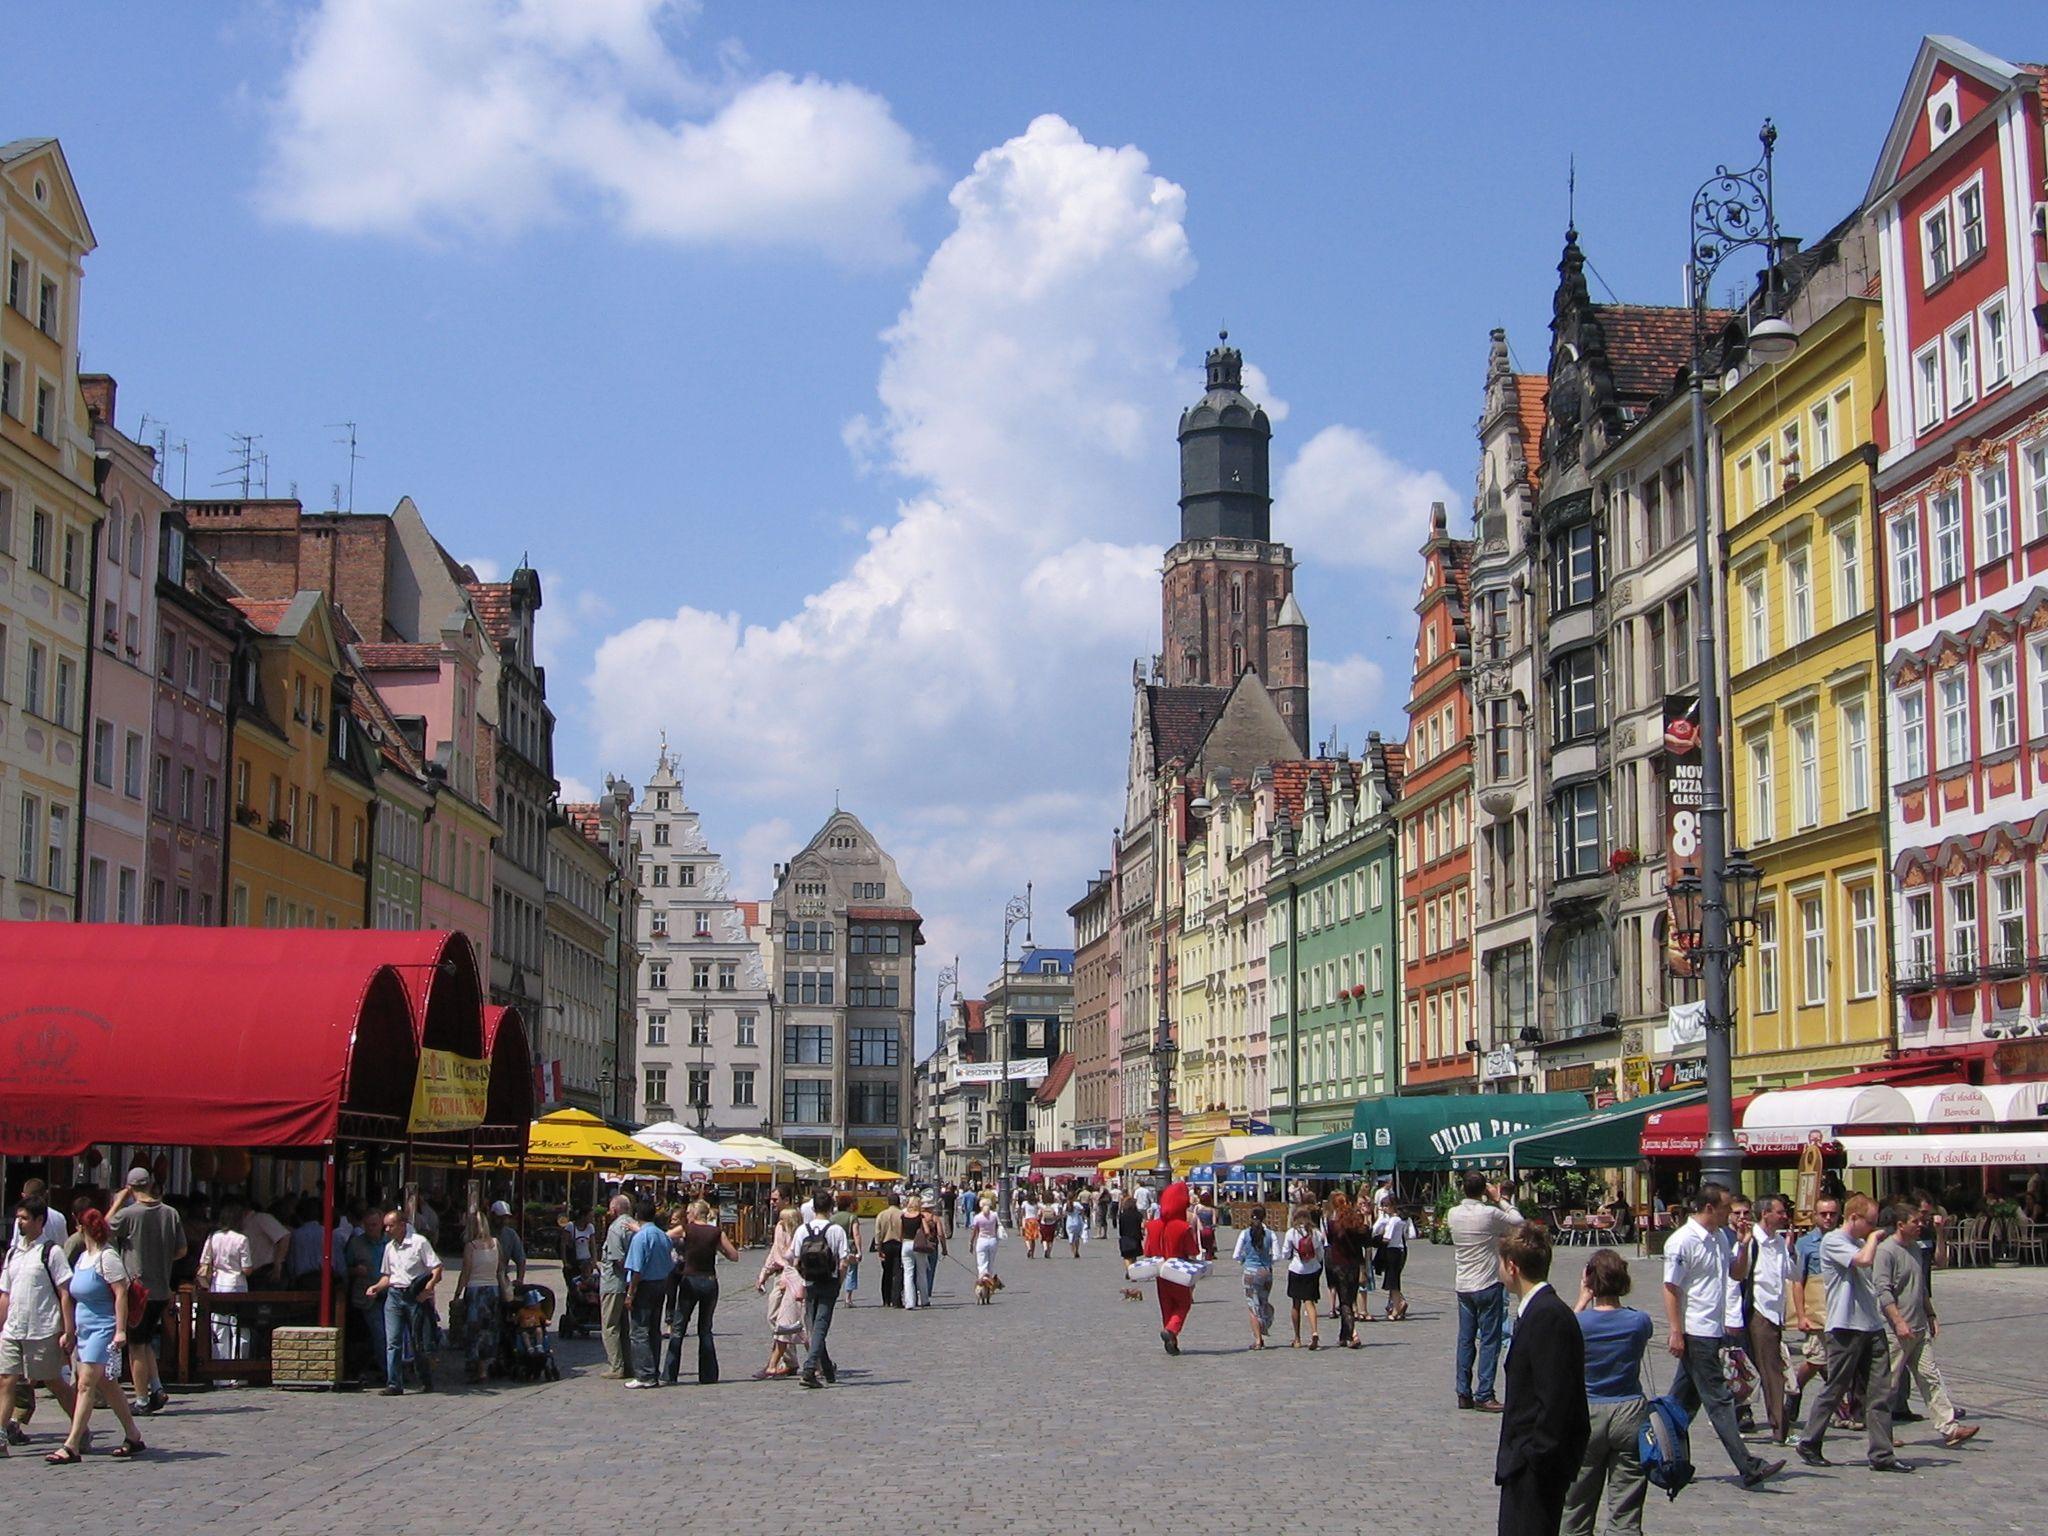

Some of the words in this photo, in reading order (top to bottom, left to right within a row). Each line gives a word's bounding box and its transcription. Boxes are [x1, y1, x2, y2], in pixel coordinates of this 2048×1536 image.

[1669, 779, 1702, 793] PIZZA
[1430, 1122, 1482, 1155] UNION
[1922, 1151, 1943, 1163] Pod
